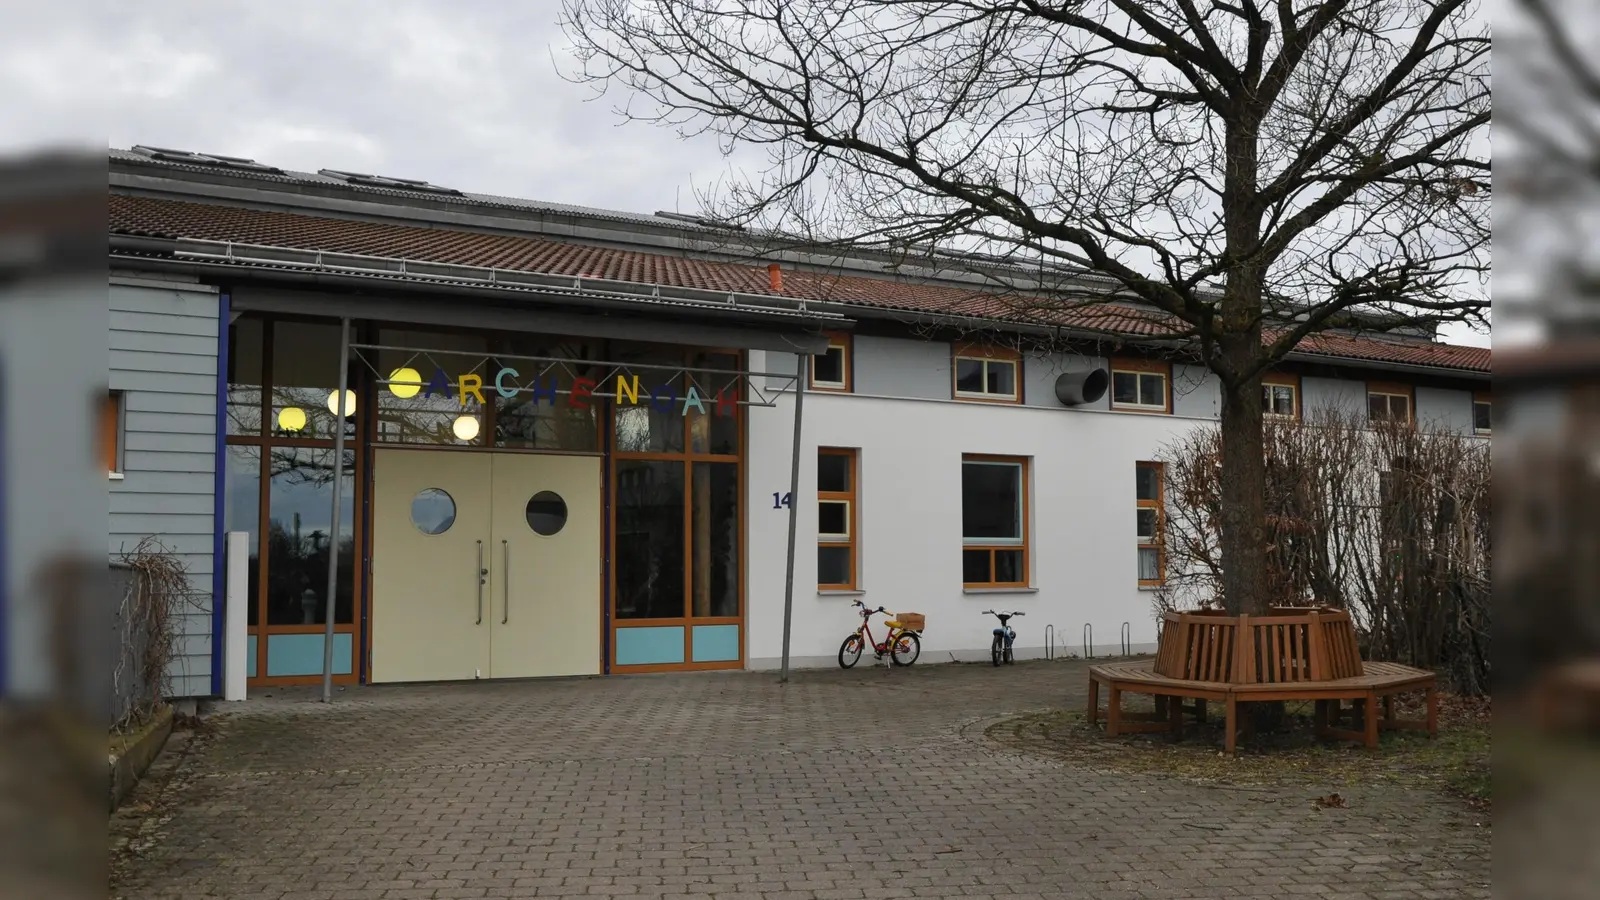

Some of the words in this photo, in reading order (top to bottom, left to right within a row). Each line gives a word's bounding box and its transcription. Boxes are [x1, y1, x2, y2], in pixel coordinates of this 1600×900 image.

[425, 367, 596, 409] ARCHE
[616, 375, 738, 418] NOAH
[772, 492, 791, 509] 14
